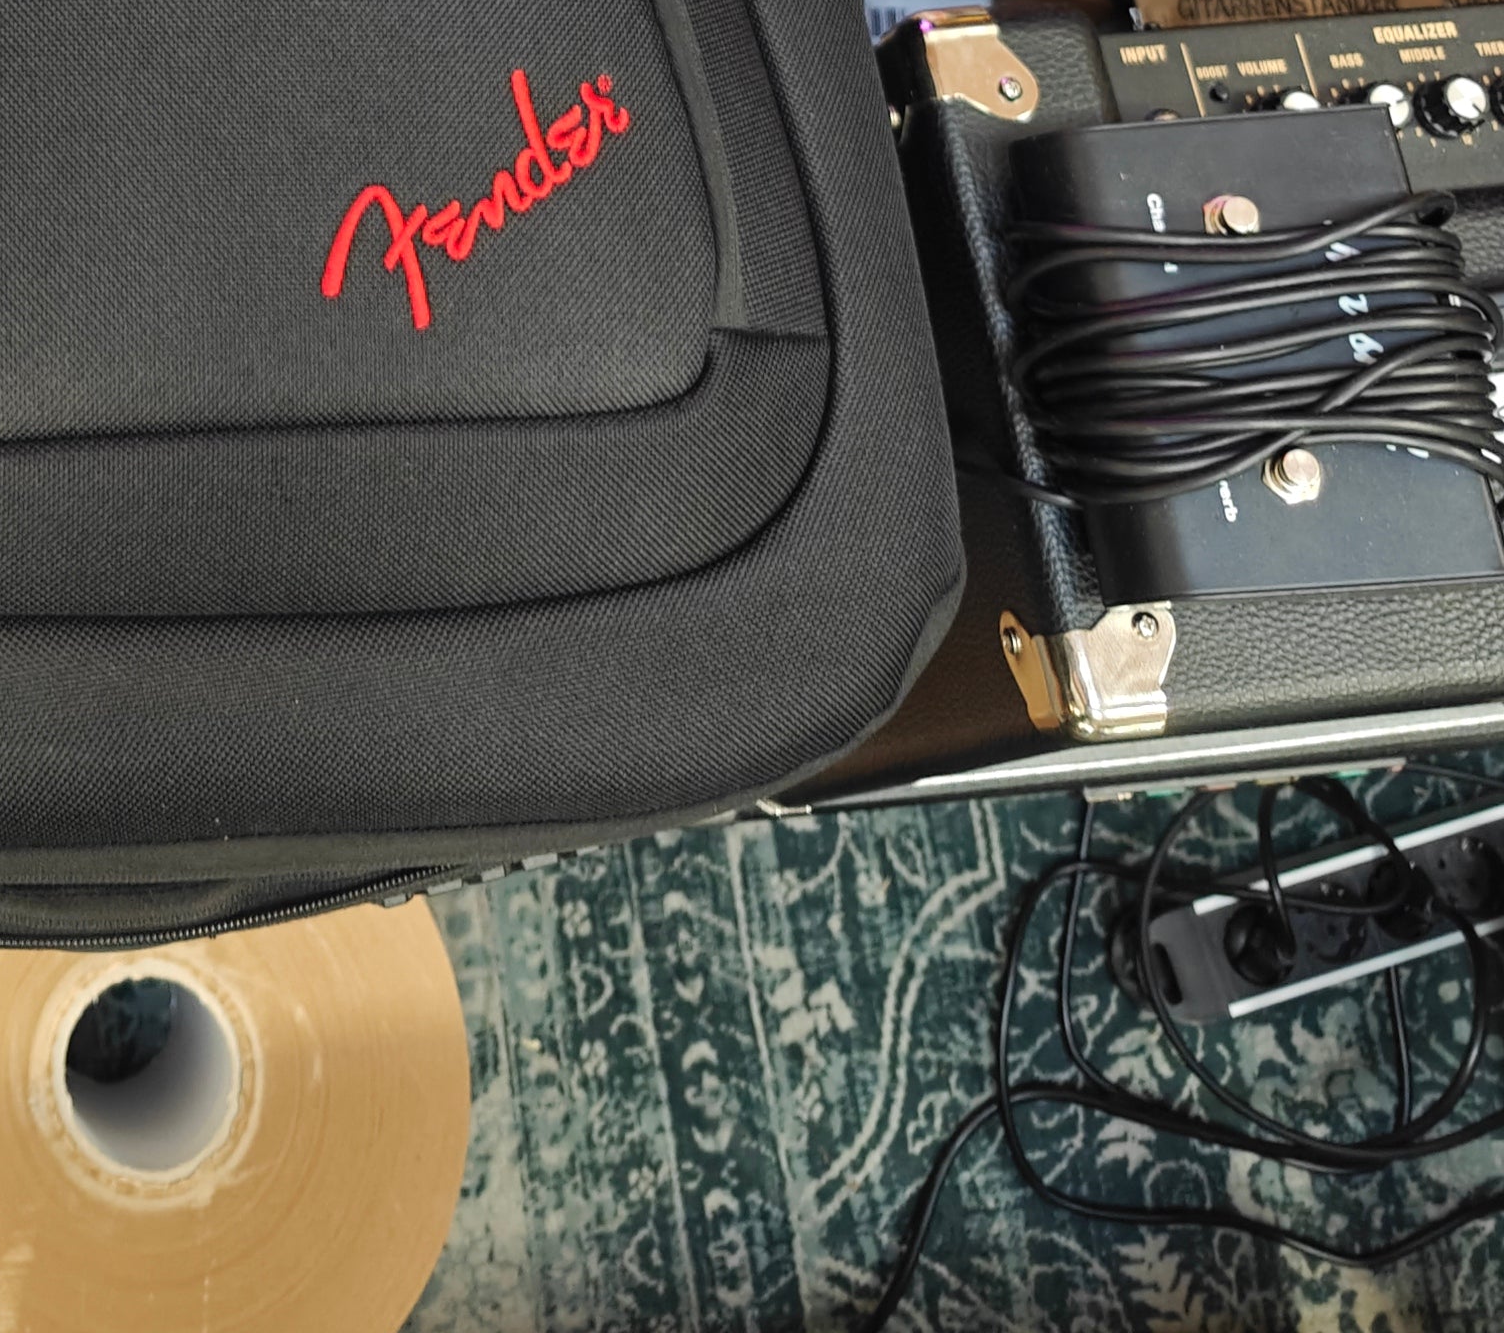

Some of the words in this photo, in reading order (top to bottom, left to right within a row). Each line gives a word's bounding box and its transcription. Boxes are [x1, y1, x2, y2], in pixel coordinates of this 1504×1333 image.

[1373, 21, 1458, 45] EQUALIZER
[1120, 44, 1167, 65] INPUT
[1329, 52, 1363, 69] BASS
[1398, 45, 1446, 64] MIDDLE
[1196, 64, 1228, 80] BOOST
[1236, 58, 1287, 76] VOLUME
[321, 68, 630, 331] Fender
